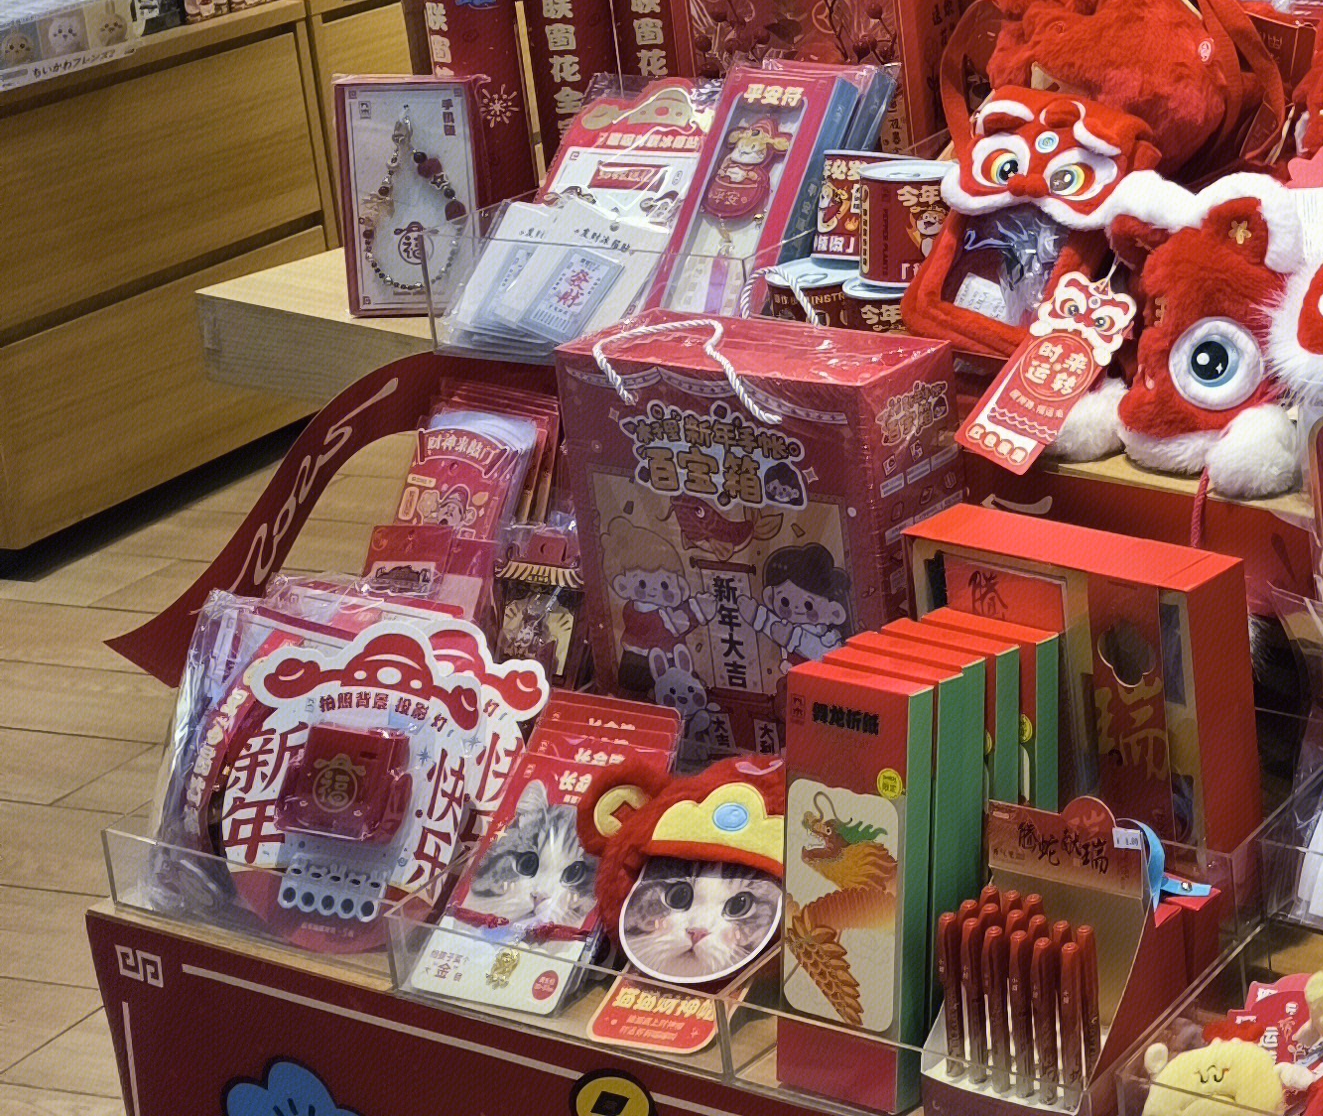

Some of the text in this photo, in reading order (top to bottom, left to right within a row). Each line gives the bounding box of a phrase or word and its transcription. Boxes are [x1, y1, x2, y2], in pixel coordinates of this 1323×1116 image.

[744, 84, 804, 106] 平安符
[646, 447, 763, 502] 百宝箱
[713, 575, 748, 689] 新年大吉
[712, 716, 730, 749] 大吉
